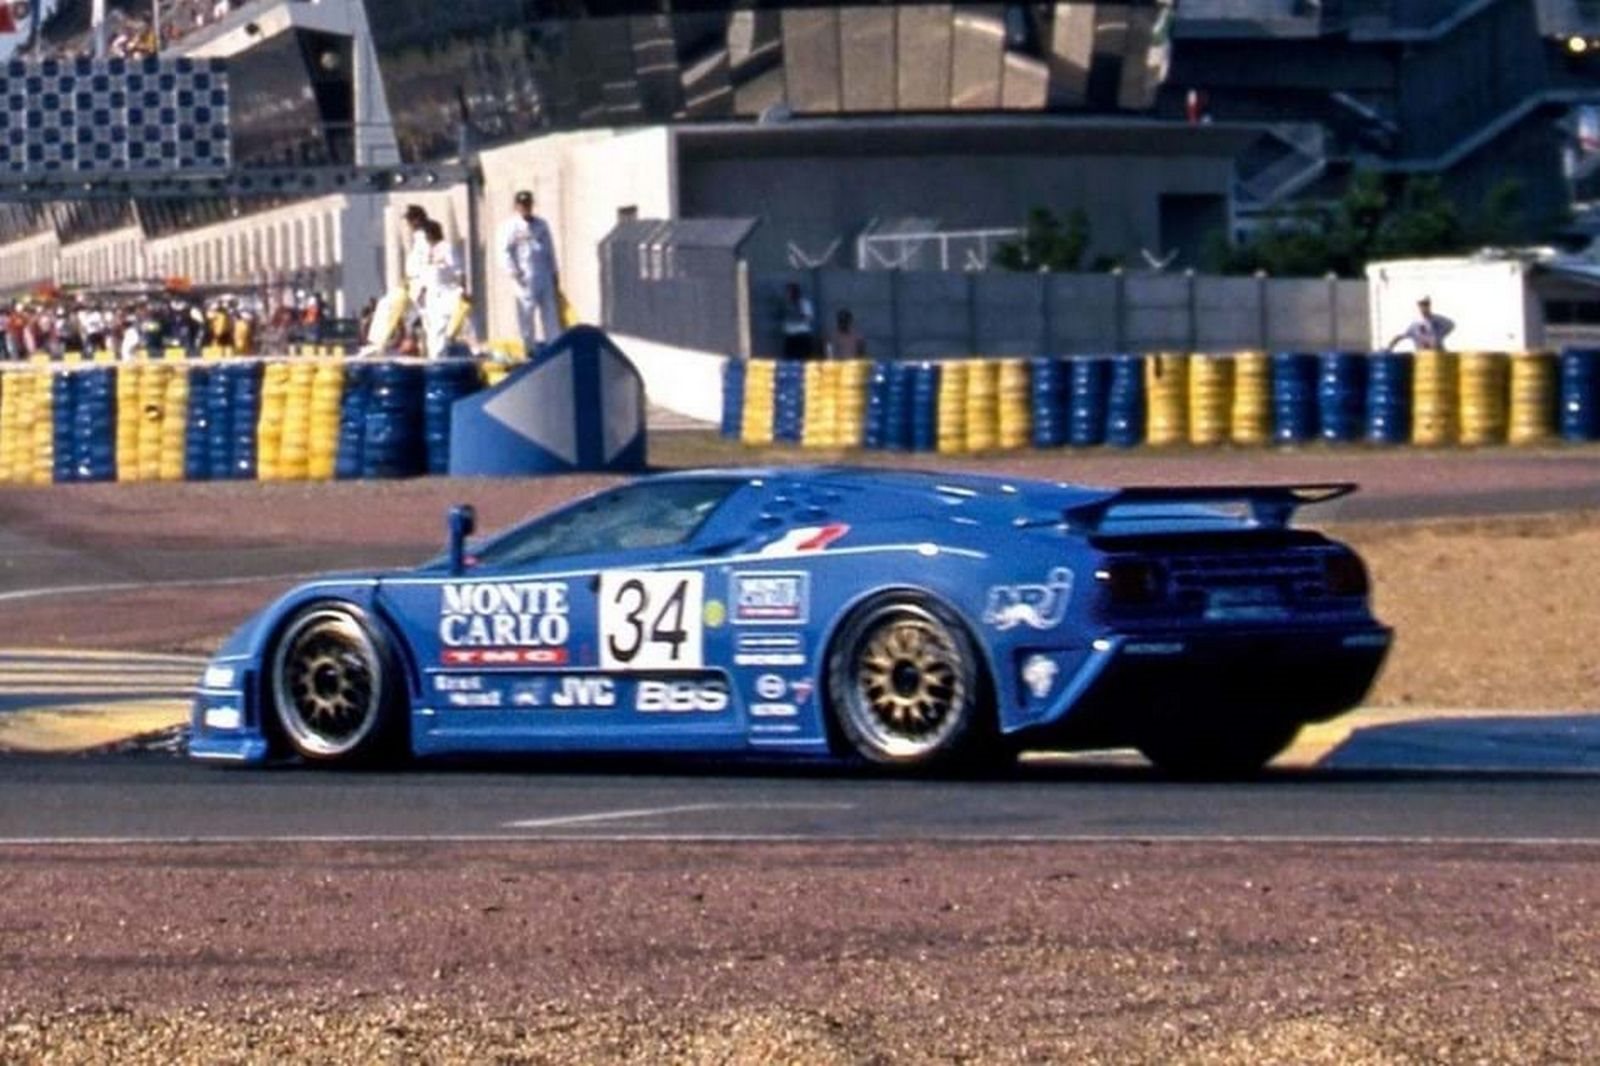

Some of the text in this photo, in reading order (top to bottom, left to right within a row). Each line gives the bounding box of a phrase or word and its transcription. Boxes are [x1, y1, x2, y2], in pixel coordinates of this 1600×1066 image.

[440, 582, 569, 615] MONTE
[440, 614, 569, 646] CARLO
[608, 578, 688, 663] 34
[552, 676, 615, 706] JVC
[636, 680, 728, 711] BBS
